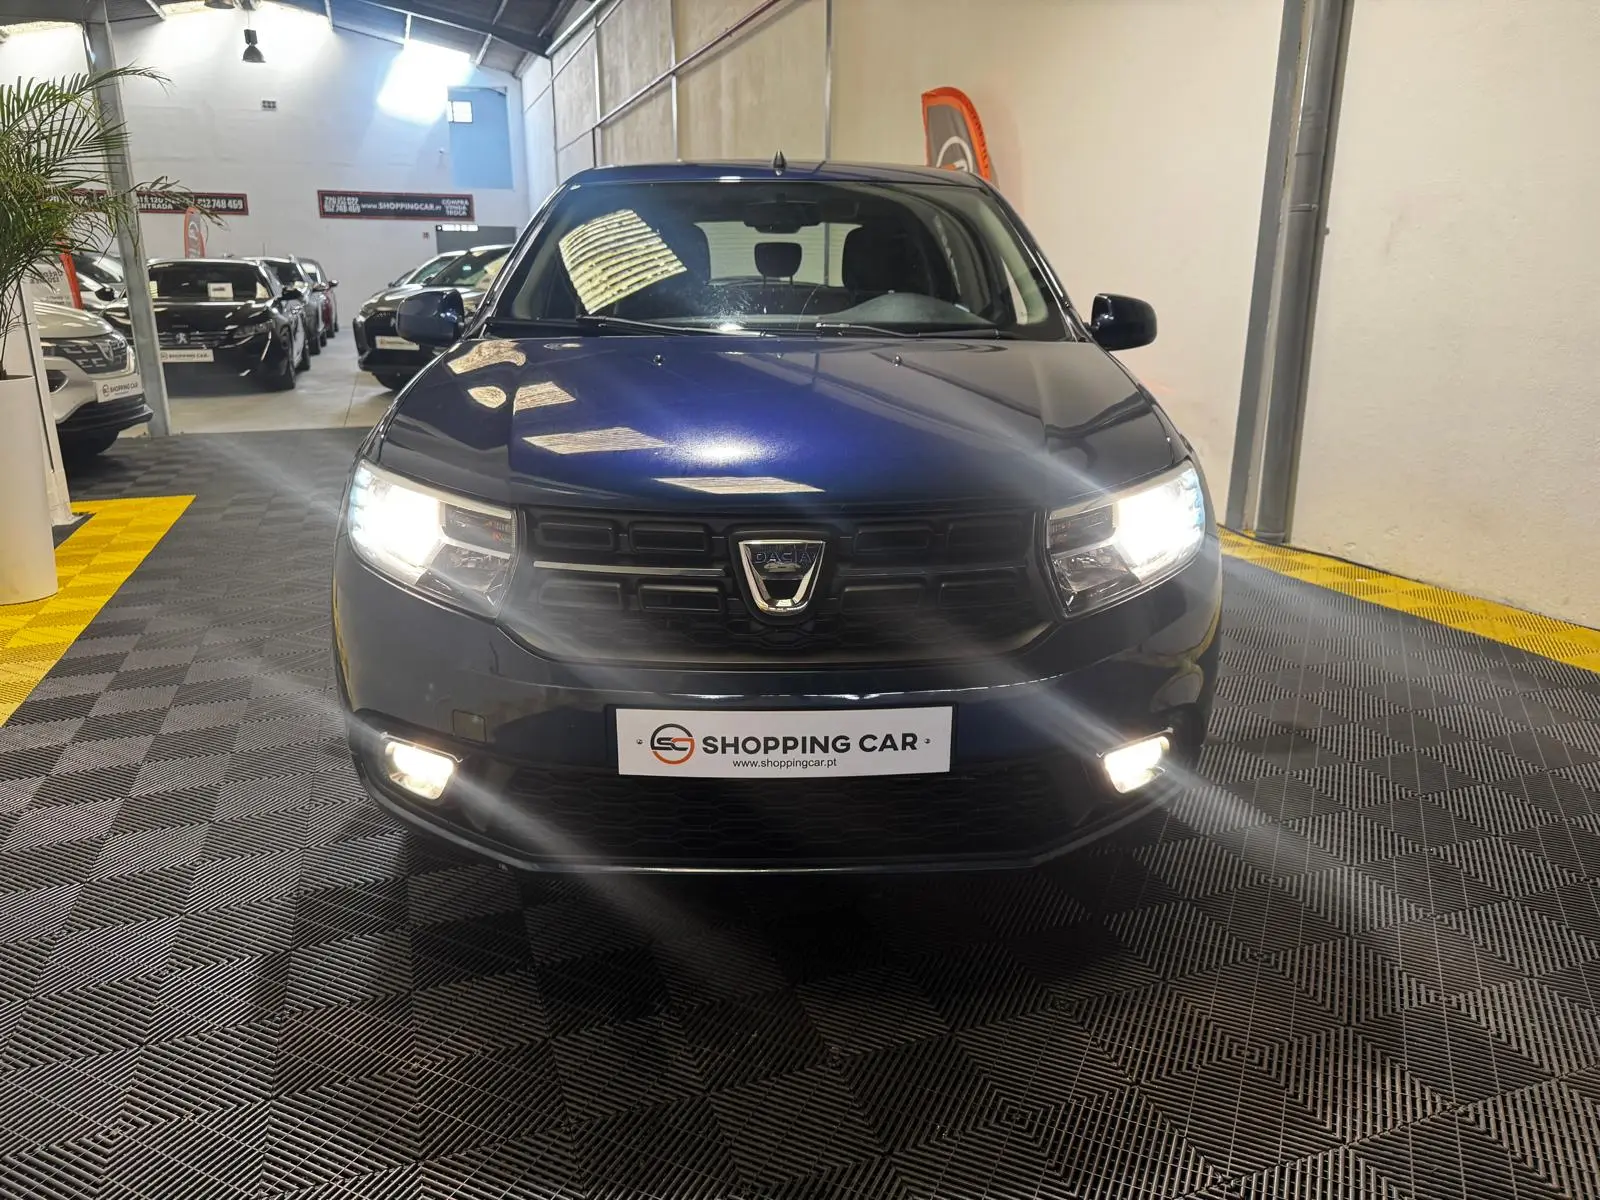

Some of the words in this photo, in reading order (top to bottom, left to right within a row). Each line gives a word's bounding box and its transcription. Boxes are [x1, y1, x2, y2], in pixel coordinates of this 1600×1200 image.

[755, 551, 813, 564] DACIA
[702, 735, 851, 755] SHOPPING
[858, 732, 918, 752] CAR
[732, 757, 837, 770] www.shoppingcar.pt
